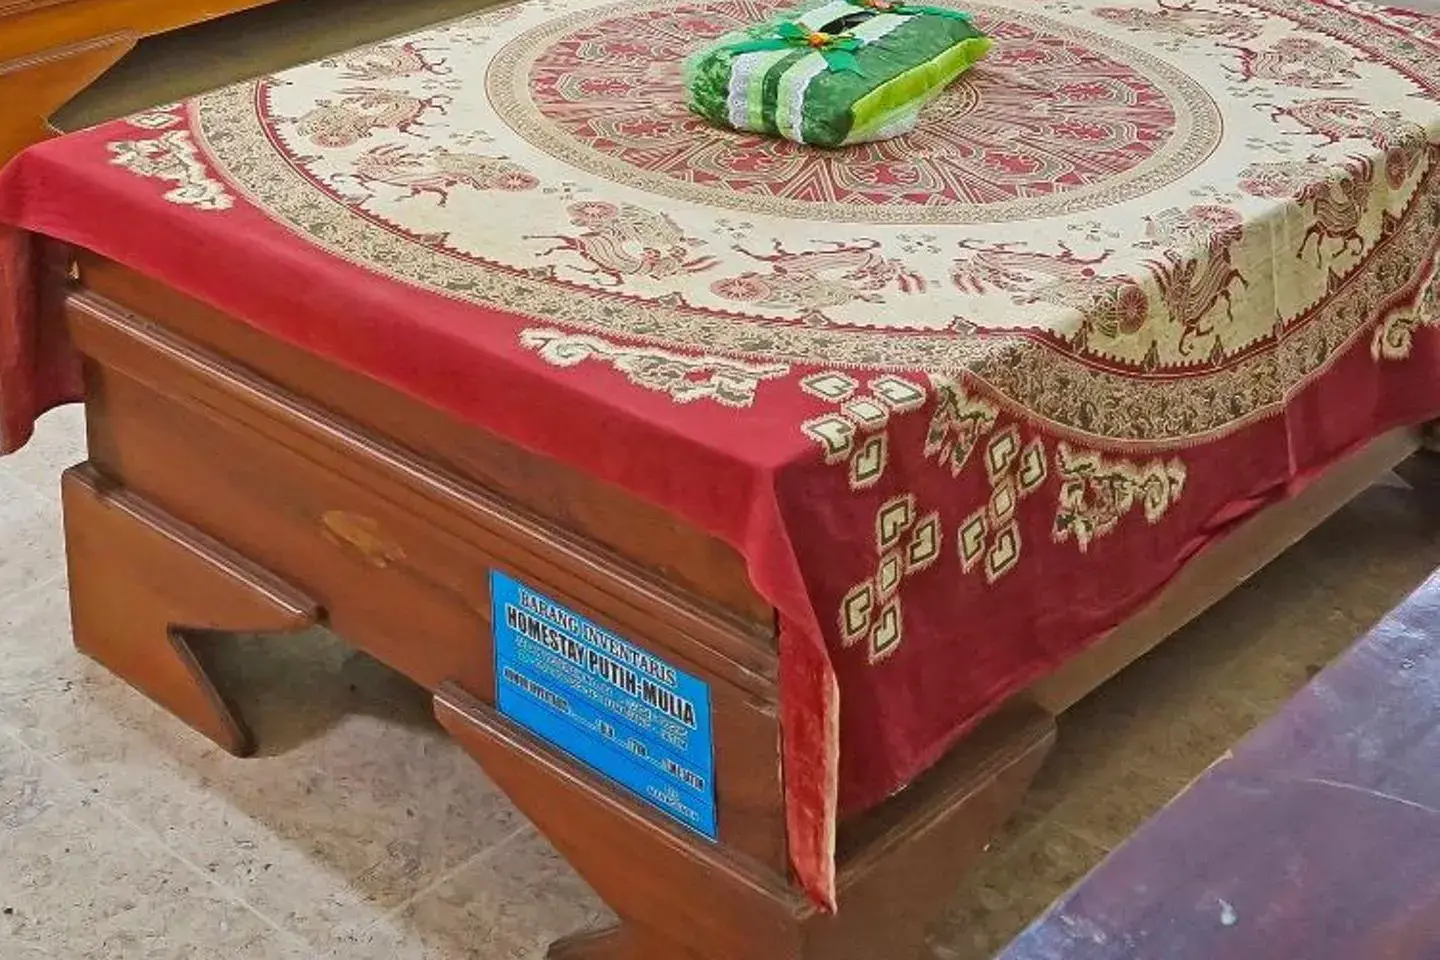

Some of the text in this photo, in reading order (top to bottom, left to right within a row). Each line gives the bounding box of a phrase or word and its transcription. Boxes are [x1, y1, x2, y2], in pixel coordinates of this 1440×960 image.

[506, 604, 586, 666] HOMESTAY
[519, 588, 578, 632] BARANG
[585, 624, 677, 687] INVENTARIS
